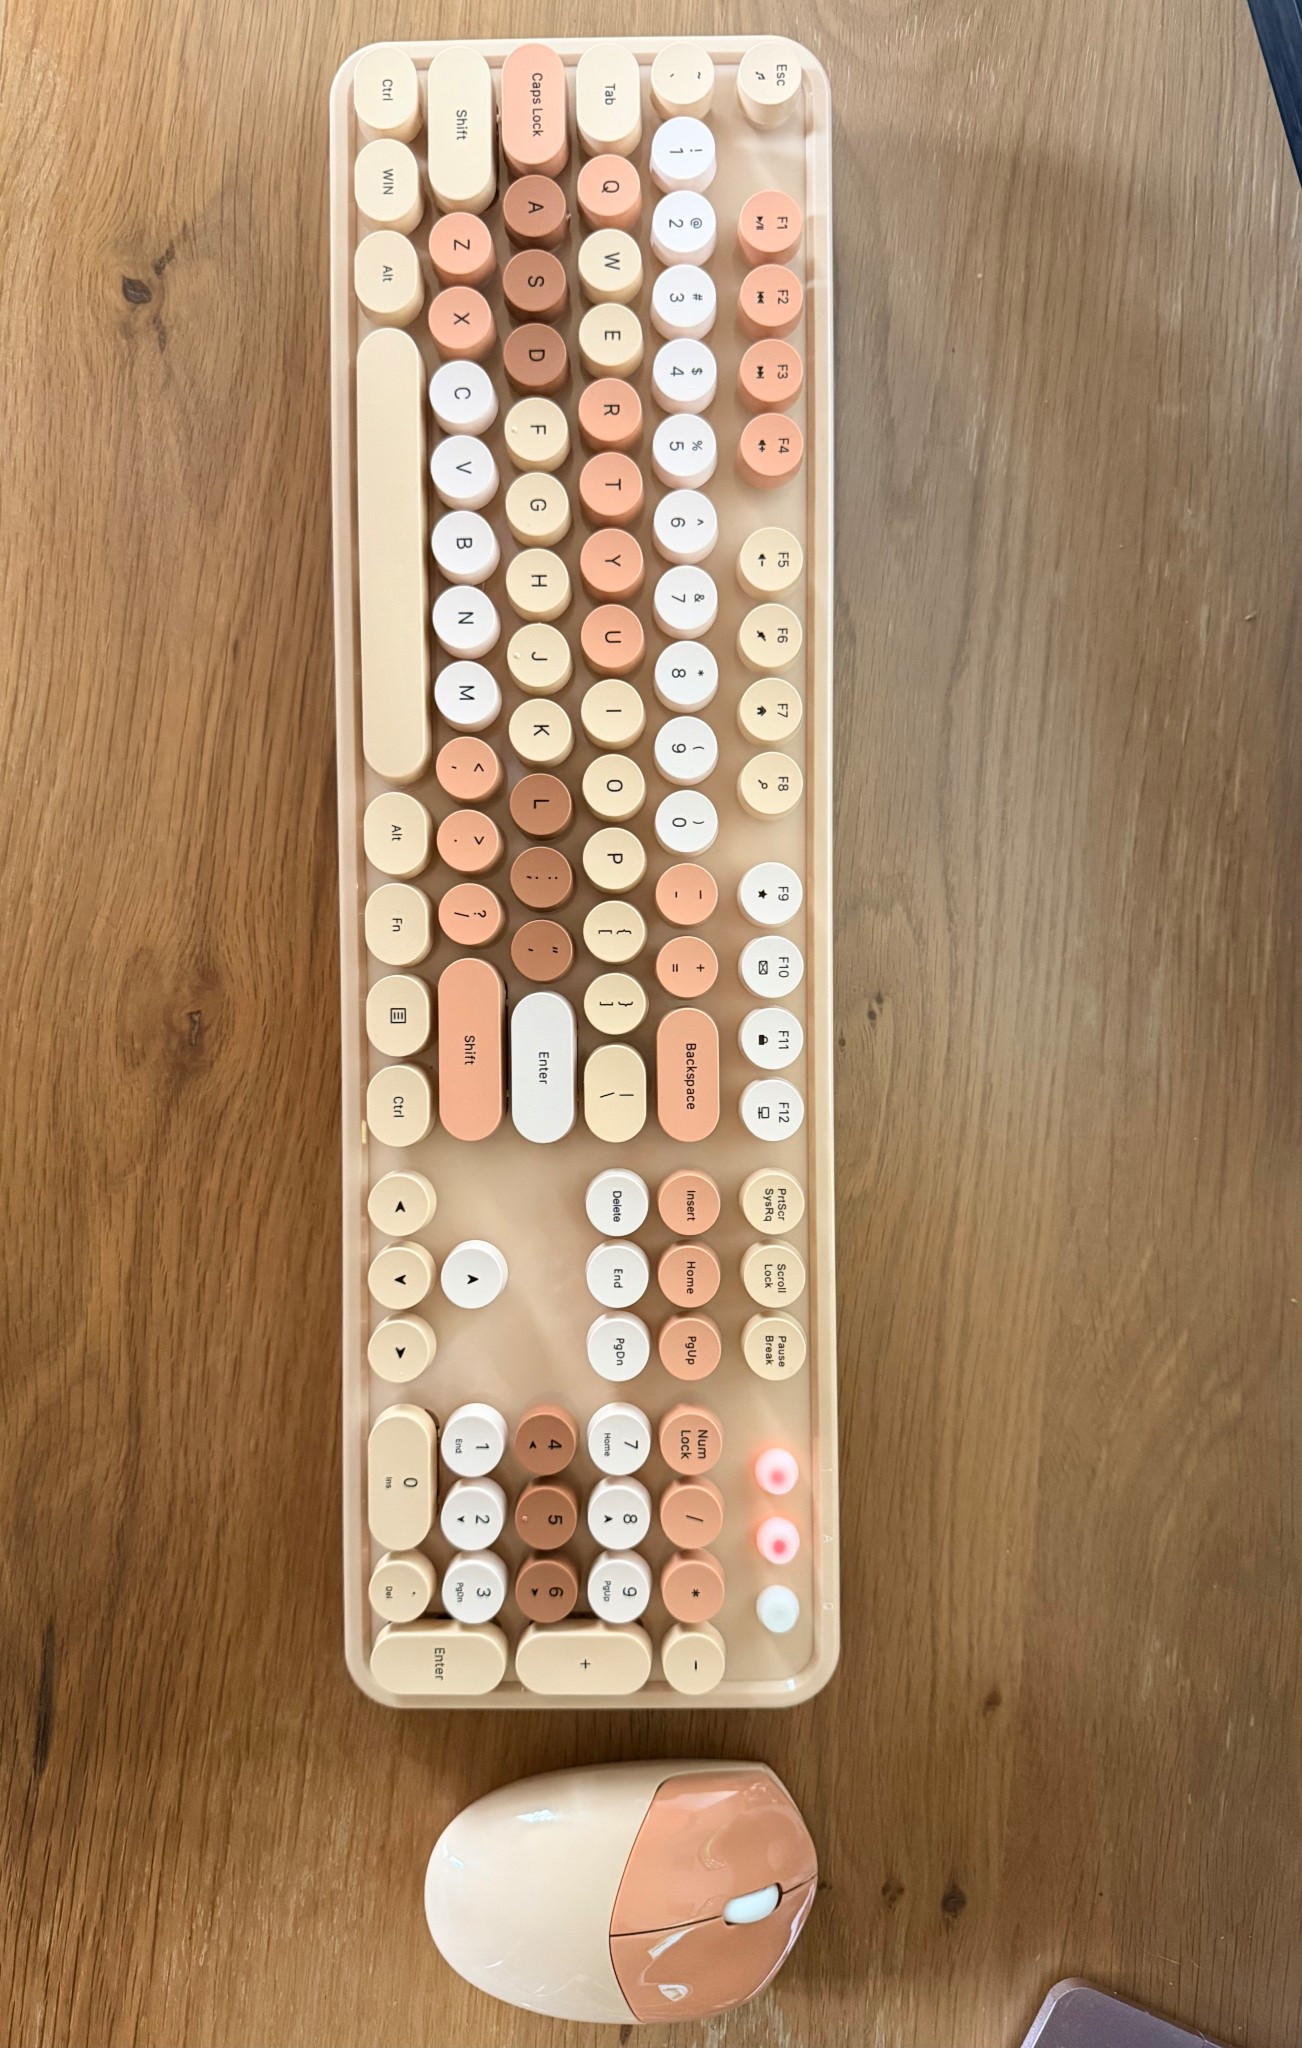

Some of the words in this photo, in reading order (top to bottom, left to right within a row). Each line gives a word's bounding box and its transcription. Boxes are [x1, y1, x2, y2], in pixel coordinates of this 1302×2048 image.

[776, 64, 788, 87] Esc
[382, 78, 394, 101] Ctrl
[529, 72, 543, 105] Caps
[604, 83, 617, 106] Tab
[456, 109, 468, 141] Shift
[531, 107, 545, 137] Lock
[382, 168, 394, 195] WIN
[601, 180, 620, 194] Q
[527, 200, 545, 214] A
[668, 218, 684, 228] 2
[689, 217, 703, 230] @
[776, 216, 789, 230] F1
[453, 239, 471, 251] Z
[604, 251, 621, 271] W
[382, 265, 394, 282] Alt
[527, 275, 545, 288] S
[669, 292, 685, 303] 3
[692, 293, 703, 301] #
[777, 289, 789, 305] F2
[453, 312, 470, 325] X
[604, 330, 621, 341] E
[528, 348, 546, 362] D
[670, 366, 685, 377] 4
[690, 367, 704, 376] $
[777, 364, 789, 380] F3
[453, 386, 472, 400] C
[603, 404, 621, 416] R
[530, 424, 547, 435] F
[669, 441, 685, 452] 5
[691, 440, 703, 452] %
[778, 437, 790, 454] F4
[455, 461, 472, 475] V
[604, 478, 622, 491] T
[529, 498, 547, 512] G
[670, 517, 686, 528] 6
[456, 537, 473, 550] B
[604, 554, 622, 567] Y
[777, 552, 790, 568] F5
[531, 574, 548, 588] H
[671, 593, 686, 603] 7
[693, 593, 705, 603] &
[457, 611, 474, 625] N
[604, 630, 622, 644] U
[776, 627, 789, 644] F6
[531, 651, 548, 662] J
[671, 668, 687, 679] 8
[459, 685, 475, 701] M
[777, 703, 789, 718] F7
[533, 724, 550, 737] K
[671, 743, 687, 754] 9
[473, 762, 485, 772] <
[606, 779, 624, 793] O
[777, 776, 789, 792] F8
[533, 799, 550, 810] L
[671, 817, 687, 828] 0
[391, 824, 403, 841] Alt
[473, 836, 485, 846] >
[607, 853, 624, 865] P
[777, 886, 790, 902] F9
[473, 909, 487, 918] ?
[392, 917, 403, 932] Fn
[672, 963, 679, 973] =
[696, 963, 705, 973] +
[778, 956, 790, 978] F10
[778, 1030, 790, 1050] F11
[464, 1035, 477, 1065] Shift
[538, 1051, 550, 1085] Enter
[683, 1043, 698, 1110] Backspace
[599, 1091, 615, 1099] \
[393, 1096, 405, 1118] Ctrl
[778, 1102, 790, 1123] F12
[612, 1190, 623, 1223] Delete
[686, 1190, 697, 1221] Insert
[762, 1188, 774, 1222] SysRq
[777, 1188, 787, 1221] PrtScr
[613, 1268, 624, 1289] End
[686, 1261, 697, 1295] Home
[764, 1263, 774, 1289] Lock
[776, 1263, 787, 1293] Scroll
[613, 1337, 626, 1366] PgDn
[684, 1335, 697, 1365] PgUp
[764, 1335, 775, 1365] Break
[777, 1335, 787, 1368] Pause
[455, 1438, 463, 1454] End
[547, 1438, 563, 1450] 4
[603, 1432, 612, 1457] Home
[624, 1440, 639, 1450] 7
[680, 1429, 692, 1460] Lock
[697, 1429, 709, 1459] Num
[385, 1476, 393, 1489] Ins
[403, 1477, 419, 1488] 0
[475, 1514, 491, 1524] 2
[547, 1514, 563, 1526] 5
[622, 1513, 638, 1524] 8
[685, 1514, 704, 1523] /
[821, 1533, 833, 1544] A
[385, 1585, 393, 1599] Del
[455, 1582, 465, 1603] PgDn
[476, 1587, 492, 1598] 3
[548, 1586, 564, 1598] 6
[602, 1580, 612, 1602] PgUp
[622, 1586, 638, 1597] 9
[434, 1647, 446, 1681] Enter
[580, 1658, 591, 1670] +
